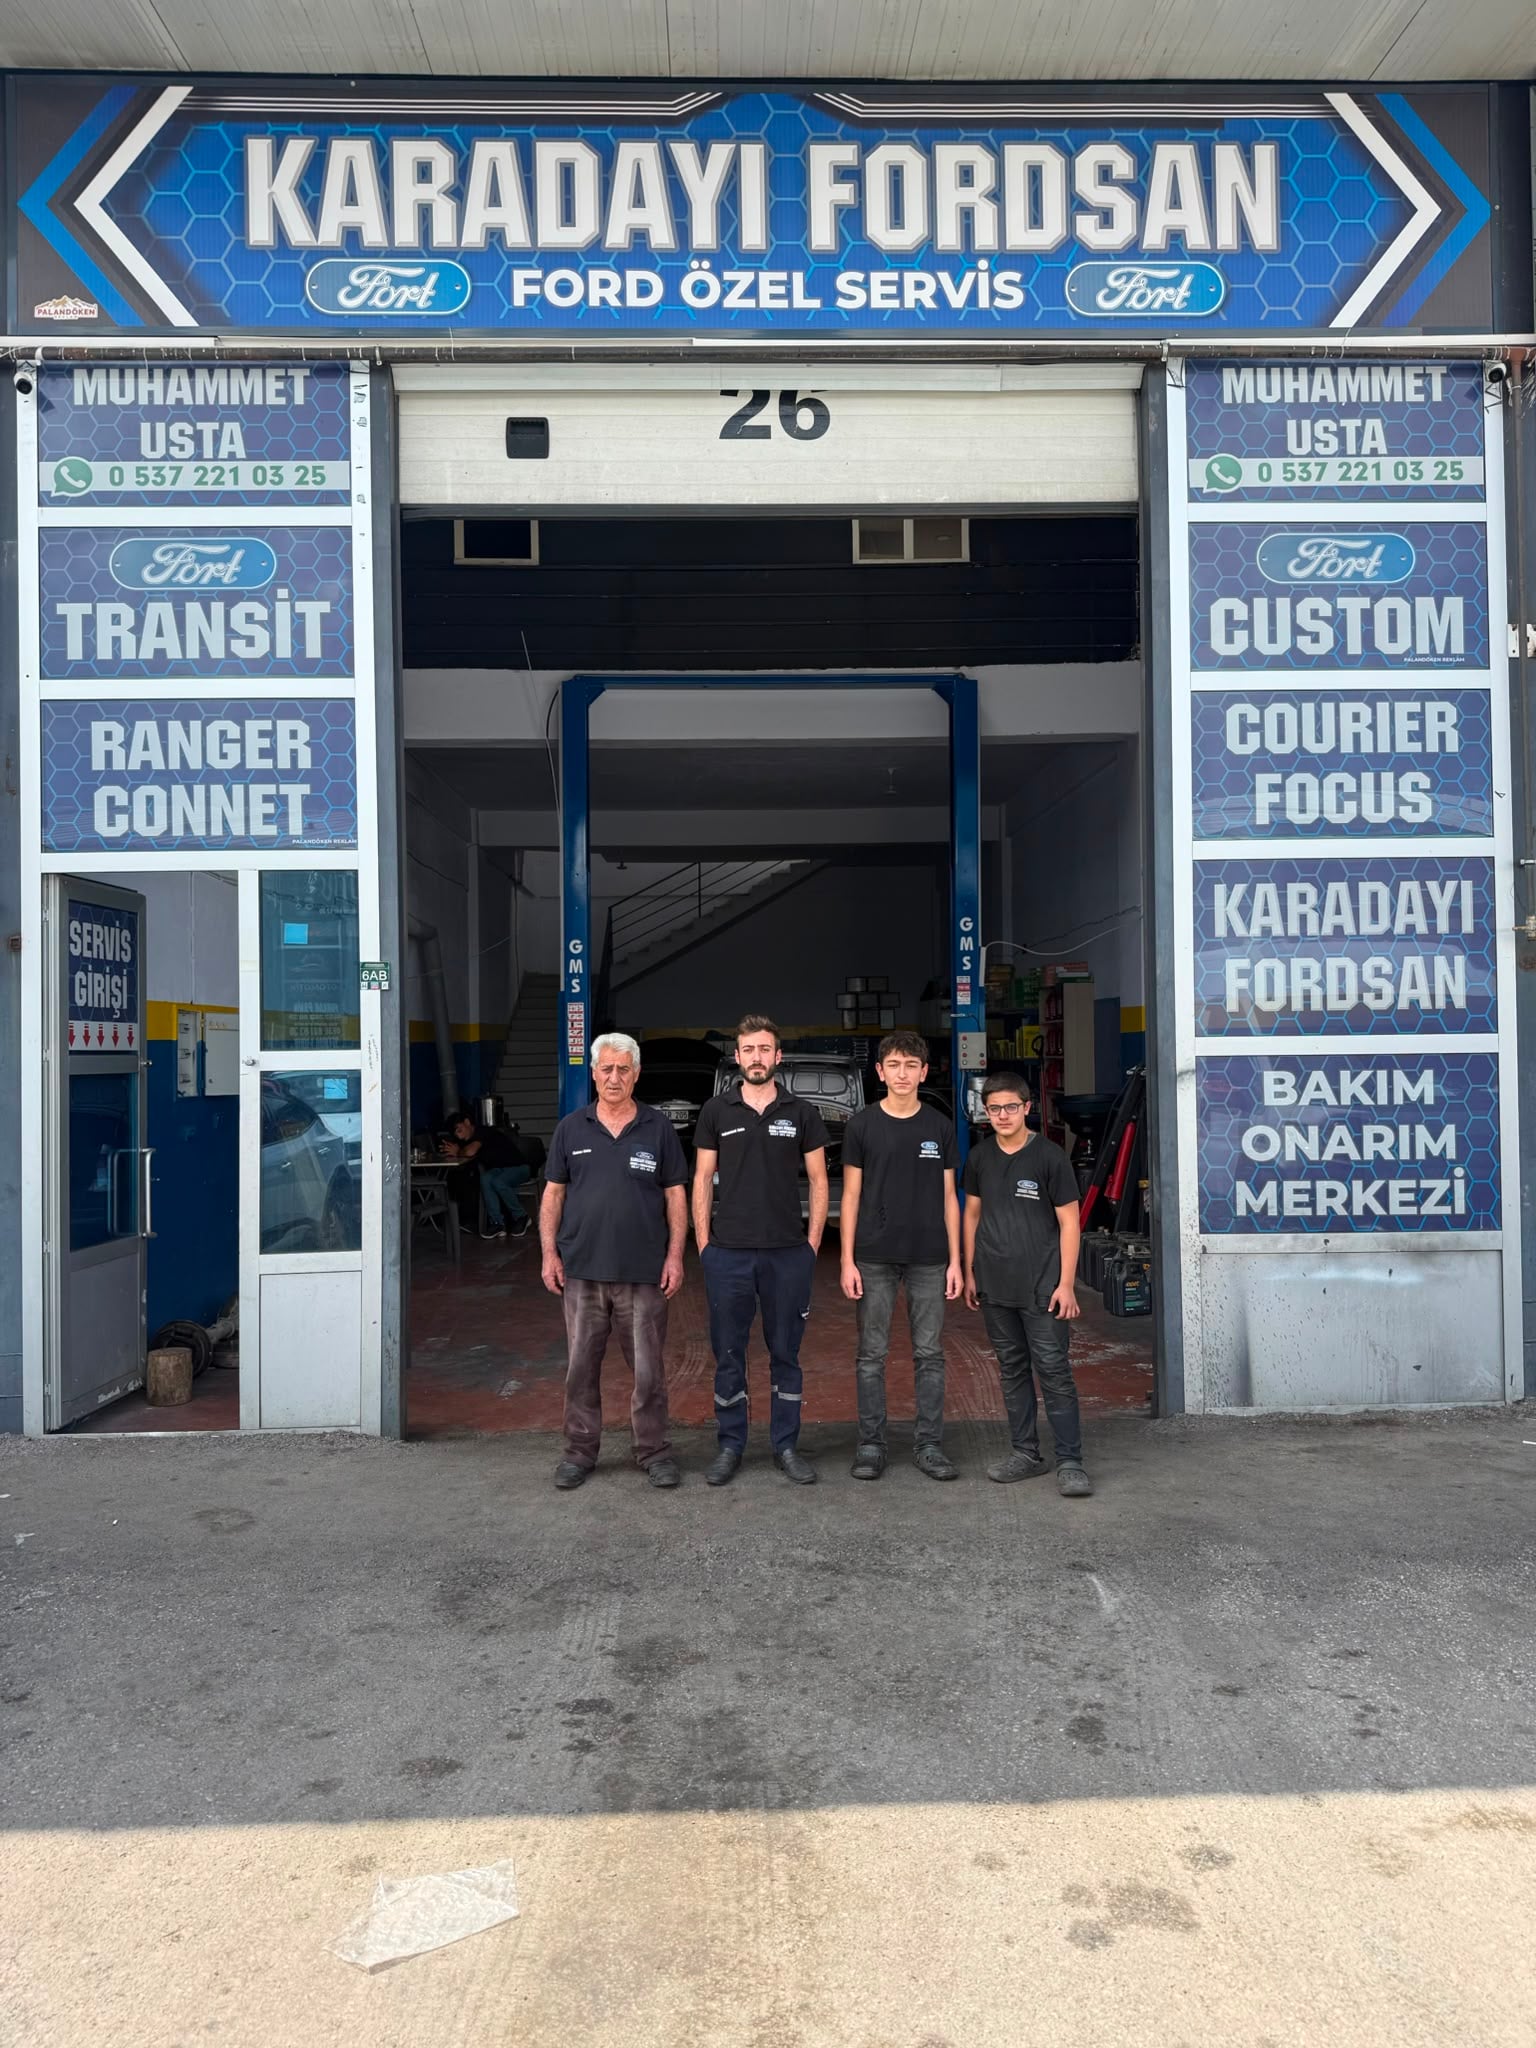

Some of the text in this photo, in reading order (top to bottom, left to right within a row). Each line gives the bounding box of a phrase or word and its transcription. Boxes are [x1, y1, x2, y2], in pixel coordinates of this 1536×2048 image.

[246, 137, 1279, 251] KARADAYI FORDSAN
[513, 259, 1024, 309] FORD ÖZEL SERVİS
[37, 307, 96, 316] PALANDÖKEN
[73, 368, 310, 406] MUHAMMET
[1222, 366, 1447, 404] MUHAMMET
[719, 389, 831, 440] 26
[1286, 418, 1388, 455] USTA
[140, 422, 246, 459] USTA
[109, 465, 327, 486] 0 537 221 03 25
[1258, 460, 1464, 482] 0 537 221 03 25
[56, 588, 331, 660] TRANSİT
[1210, 596, 1464, 656] CUSTOM
[91, 719, 312, 771] RANGER
[1225, 701, 1459, 755] COURIER
[93, 783, 311, 837] CONNET
[1255, 771, 1433, 825] FOCUS
[1213, 880, 1474, 937] KARADAYI
[69, 920, 132, 963] SERVİS
[74, 964, 128, 1018] GİRİŞİ
[362, 970, 387, 981] 6AB
[1225, 955, 1467, 1013] FORDSAN
[1262, 1069, 1435, 1106] BAKIM
[1241, 1124, 1457, 1162] ONARIM
[1235, 1166, 1466, 1217] MERKEZİ
